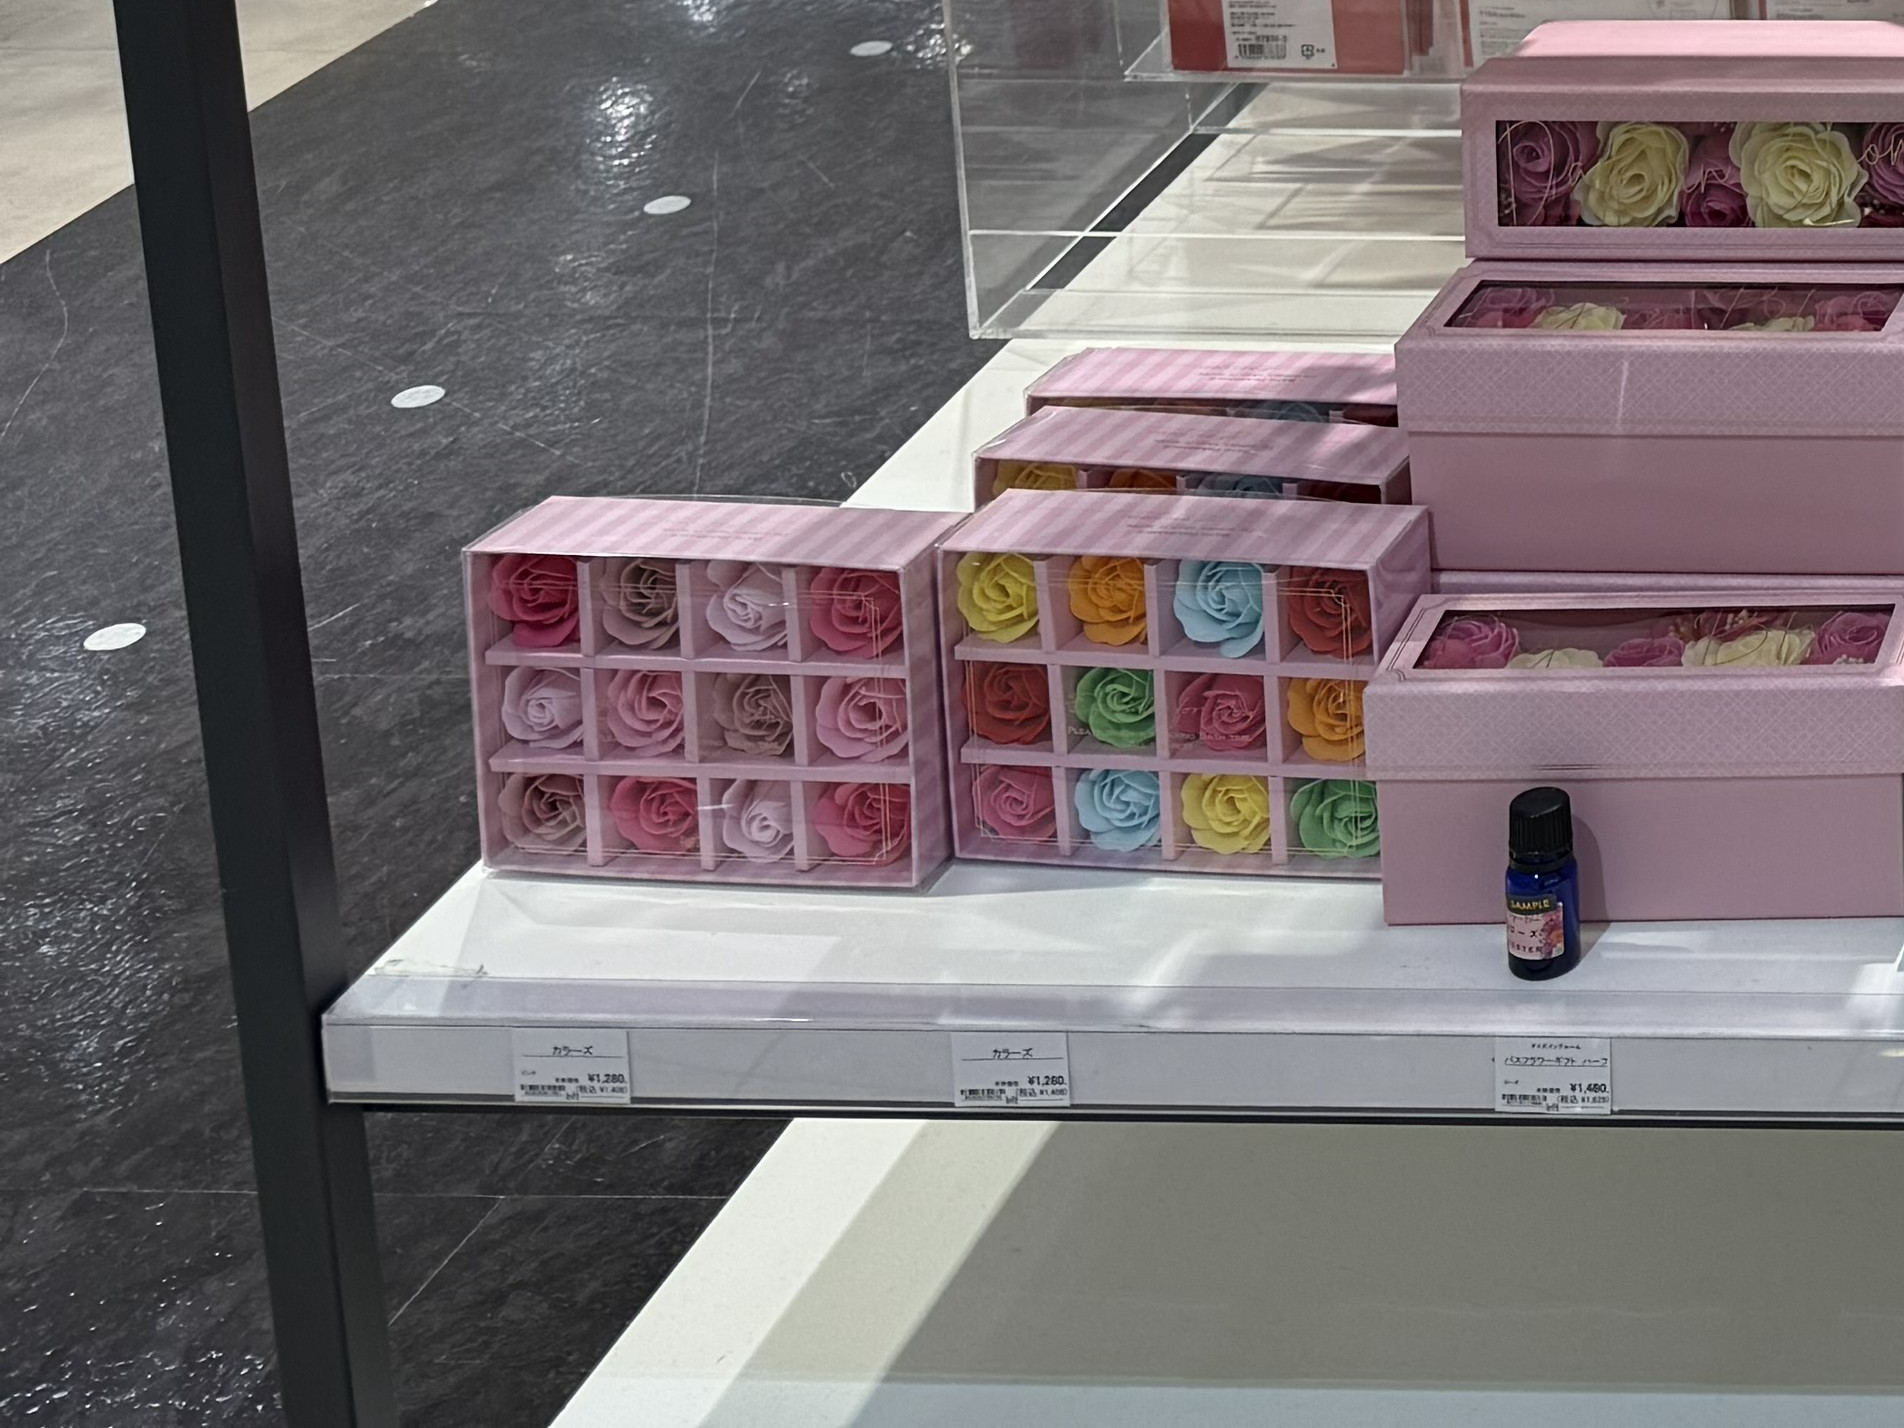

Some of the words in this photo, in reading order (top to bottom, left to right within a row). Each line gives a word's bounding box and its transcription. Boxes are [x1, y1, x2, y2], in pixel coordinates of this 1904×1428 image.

[553, 1045, 594, 1056] カラーズ
[992, 1048, 1034, 1059] カラーズ
